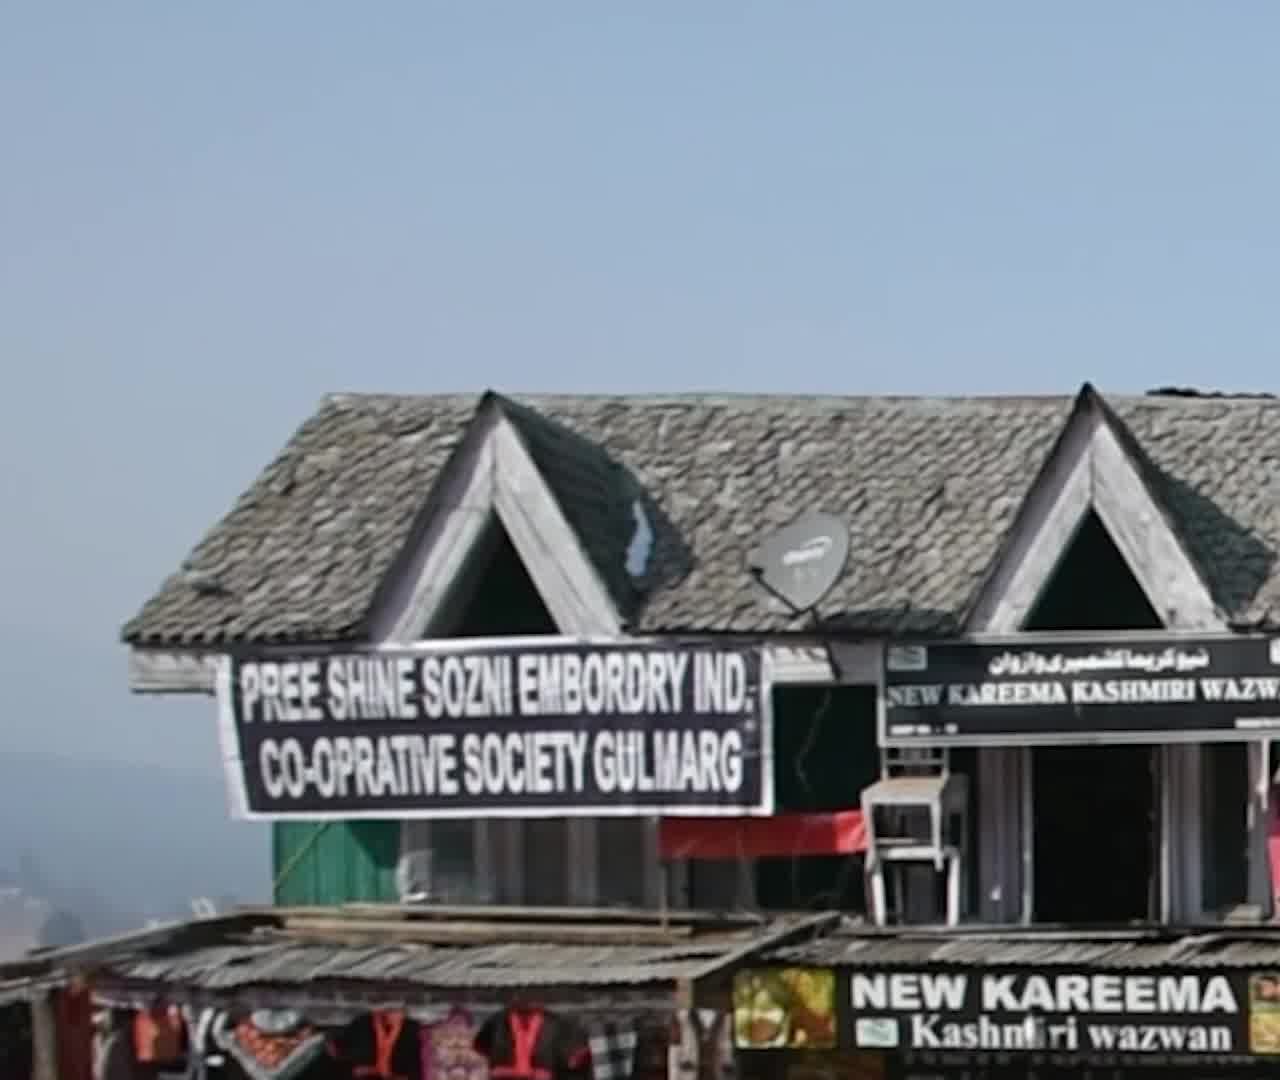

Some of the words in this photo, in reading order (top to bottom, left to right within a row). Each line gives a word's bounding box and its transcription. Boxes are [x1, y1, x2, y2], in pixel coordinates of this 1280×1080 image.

[327, 657, 417, 720] SHINE
[422, 655, 512, 719] SOZNI
[518, 653, 688, 716] EMBORDRY
[948, 682, 1067, 706] KAREEMA
[1071, 679, 1196, 704] KASHMIRI
[260, 735, 458, 799] CO-OPRATIVE
[462, 732, 588, 795] SOCIETY
[593, 730, 743, 794] GULMARG
[851, 975, 968, 1010] NEW
[982, 976, 1238, 1014] KAREEMA
[1090, 1022, 1233, 1051] wazwan
